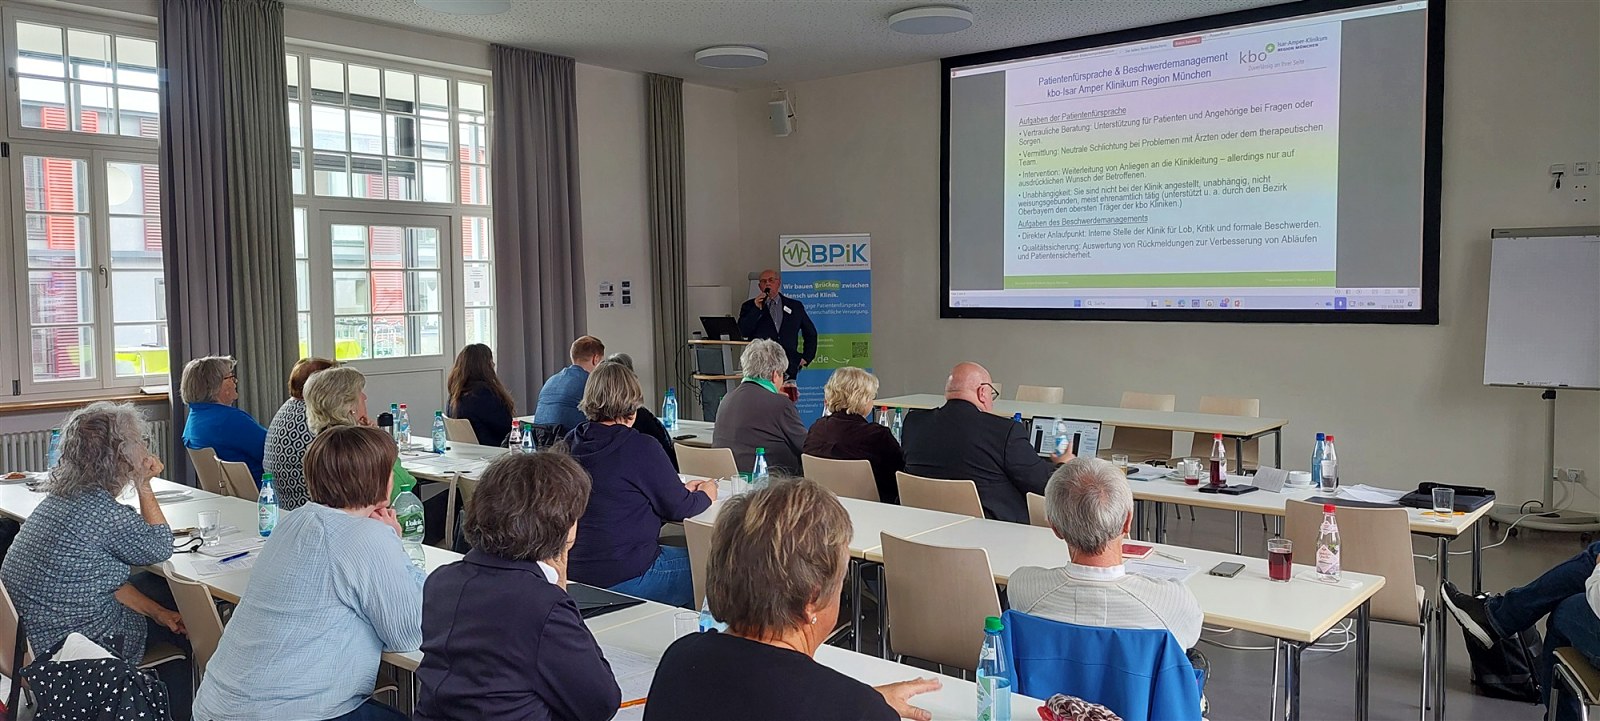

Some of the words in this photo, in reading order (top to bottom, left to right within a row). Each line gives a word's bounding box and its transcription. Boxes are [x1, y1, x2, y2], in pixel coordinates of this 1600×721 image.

[1240, 50, 1267, 64] kbo
[1038, 68, 1112, 86] Patientenfürsprache
[1122, 52, 1229, 74] Beschwerdemanagement
[1047, 84, 1076, 98] kbo-Isar
[1079, 84, 1103, 94] Amper
[1106, 78, 1139, 90] Klinikum
[1141, 74, 1170, 86] Region
[1172, 70, 1212, 84] München
[1019, 116, 1048, 125] Aufgaben
[1062, 107, 1126, 120] Patientenfürsprache
[1023, 128, 1059, 137] Vertrauliche
[1094, 119, 1140, 129] Unterstützung
[1153, 115, 1187, 123] Patienten
[1189, 111, 1203, 120] und
[1204, 107, 1249, 119] Angehörige
[1250, 104, 1263, 113] bei
[1265, 102, 1293, 113] Fragen
[1295, 100, 1314, 109] oder
[1061, 146, 1088, 154] Neutrale
[1089, 142, 1128, 152] Schlichtung
[1129, 140, 1141, 148] bei
[1142, 137, 1180, 147] Problemen
[1220, 131, 1238, 140] oder
[1240, 129, 1257, 138] dem
[1260, 124, 1324, 136] therapeutischen
[1062, 165, 1104, 176] Weiterleitung
[1105, 164, 1118, 172] von
[1120, 161, 1149, 171] Anliegen
[1161, 159, 1173, 167] die
[1174, 156, 1218, 166] Klinikleitung
[1227, 152, 1264, 163] allerdings
[1266, 151, 1279, 159] nur
[1019, 178, 1064, 187] ausdrücklichen
[1066, 176, 1091, 184] Wunsch
[1105, 172, 1147, 180] Betroffenen.
[1074, 188, 1084, 196] Sie
[1086, 187, 1099, 195] sind
[1144, 183, 1162, 191] Klinik
[1164, 180, 1200, 190] angestellt,
[1203, 177, 1249, 187] unabhängig,
[1252, 175, 1271, 183] nicht
[1018, 197, 1078, 207] weisungsgebunden,
[1100, 192, 1143, 202] ehrenamtlich
[1145, 192, 1159, 201] tätig
[1162, 189, 1202, 200] (unterstützt
[1222, 186, 1244, 194] durch
[1263, 183, 1287, 192] Bezirk
[1018, 207, 1054, 216] Oberbayern
[1069, 204, 1097, 212] obersten
[1100, 202, 1121, 211] Träger
[1135, 200, 1148, 208] kbo
[1150, 199, 1182, 208] Kliniken.)
[1018, 219, 1047, 229] Aufgaben
[1062, 214, 1148, 225] Beschwerdemanagements
[1022, 232, 1046, 240] Direkter
[1088, 229, 1111, 237] Interne
[1113, 227, 1131, 236] Stelle
[1133, 227, 1145, 235] der
[1147, 226, 1165, 234] Klinik
[1179, 225, 1195, 234] Lob,
[1197, 224, 1215, 232] Kritik
[1217, 223, 1231, 232] und
[1233, 222, 1262, 231] formale
[1264, 220, 1321, 230] Beschwerden.
[1083, 241, 1121, 250] Auswertung
[1137, 240, 1194, 249] Rückmeldungen
[1209, 235, 1262, 246] Verbesserung
[1264, 236, 1279, 244] von
[1281, 234, 1317, 243] Abläufen
[811, 244, 868, 263] BPiK
[1031, 251, 1091, 260] Patientensicherheit.
